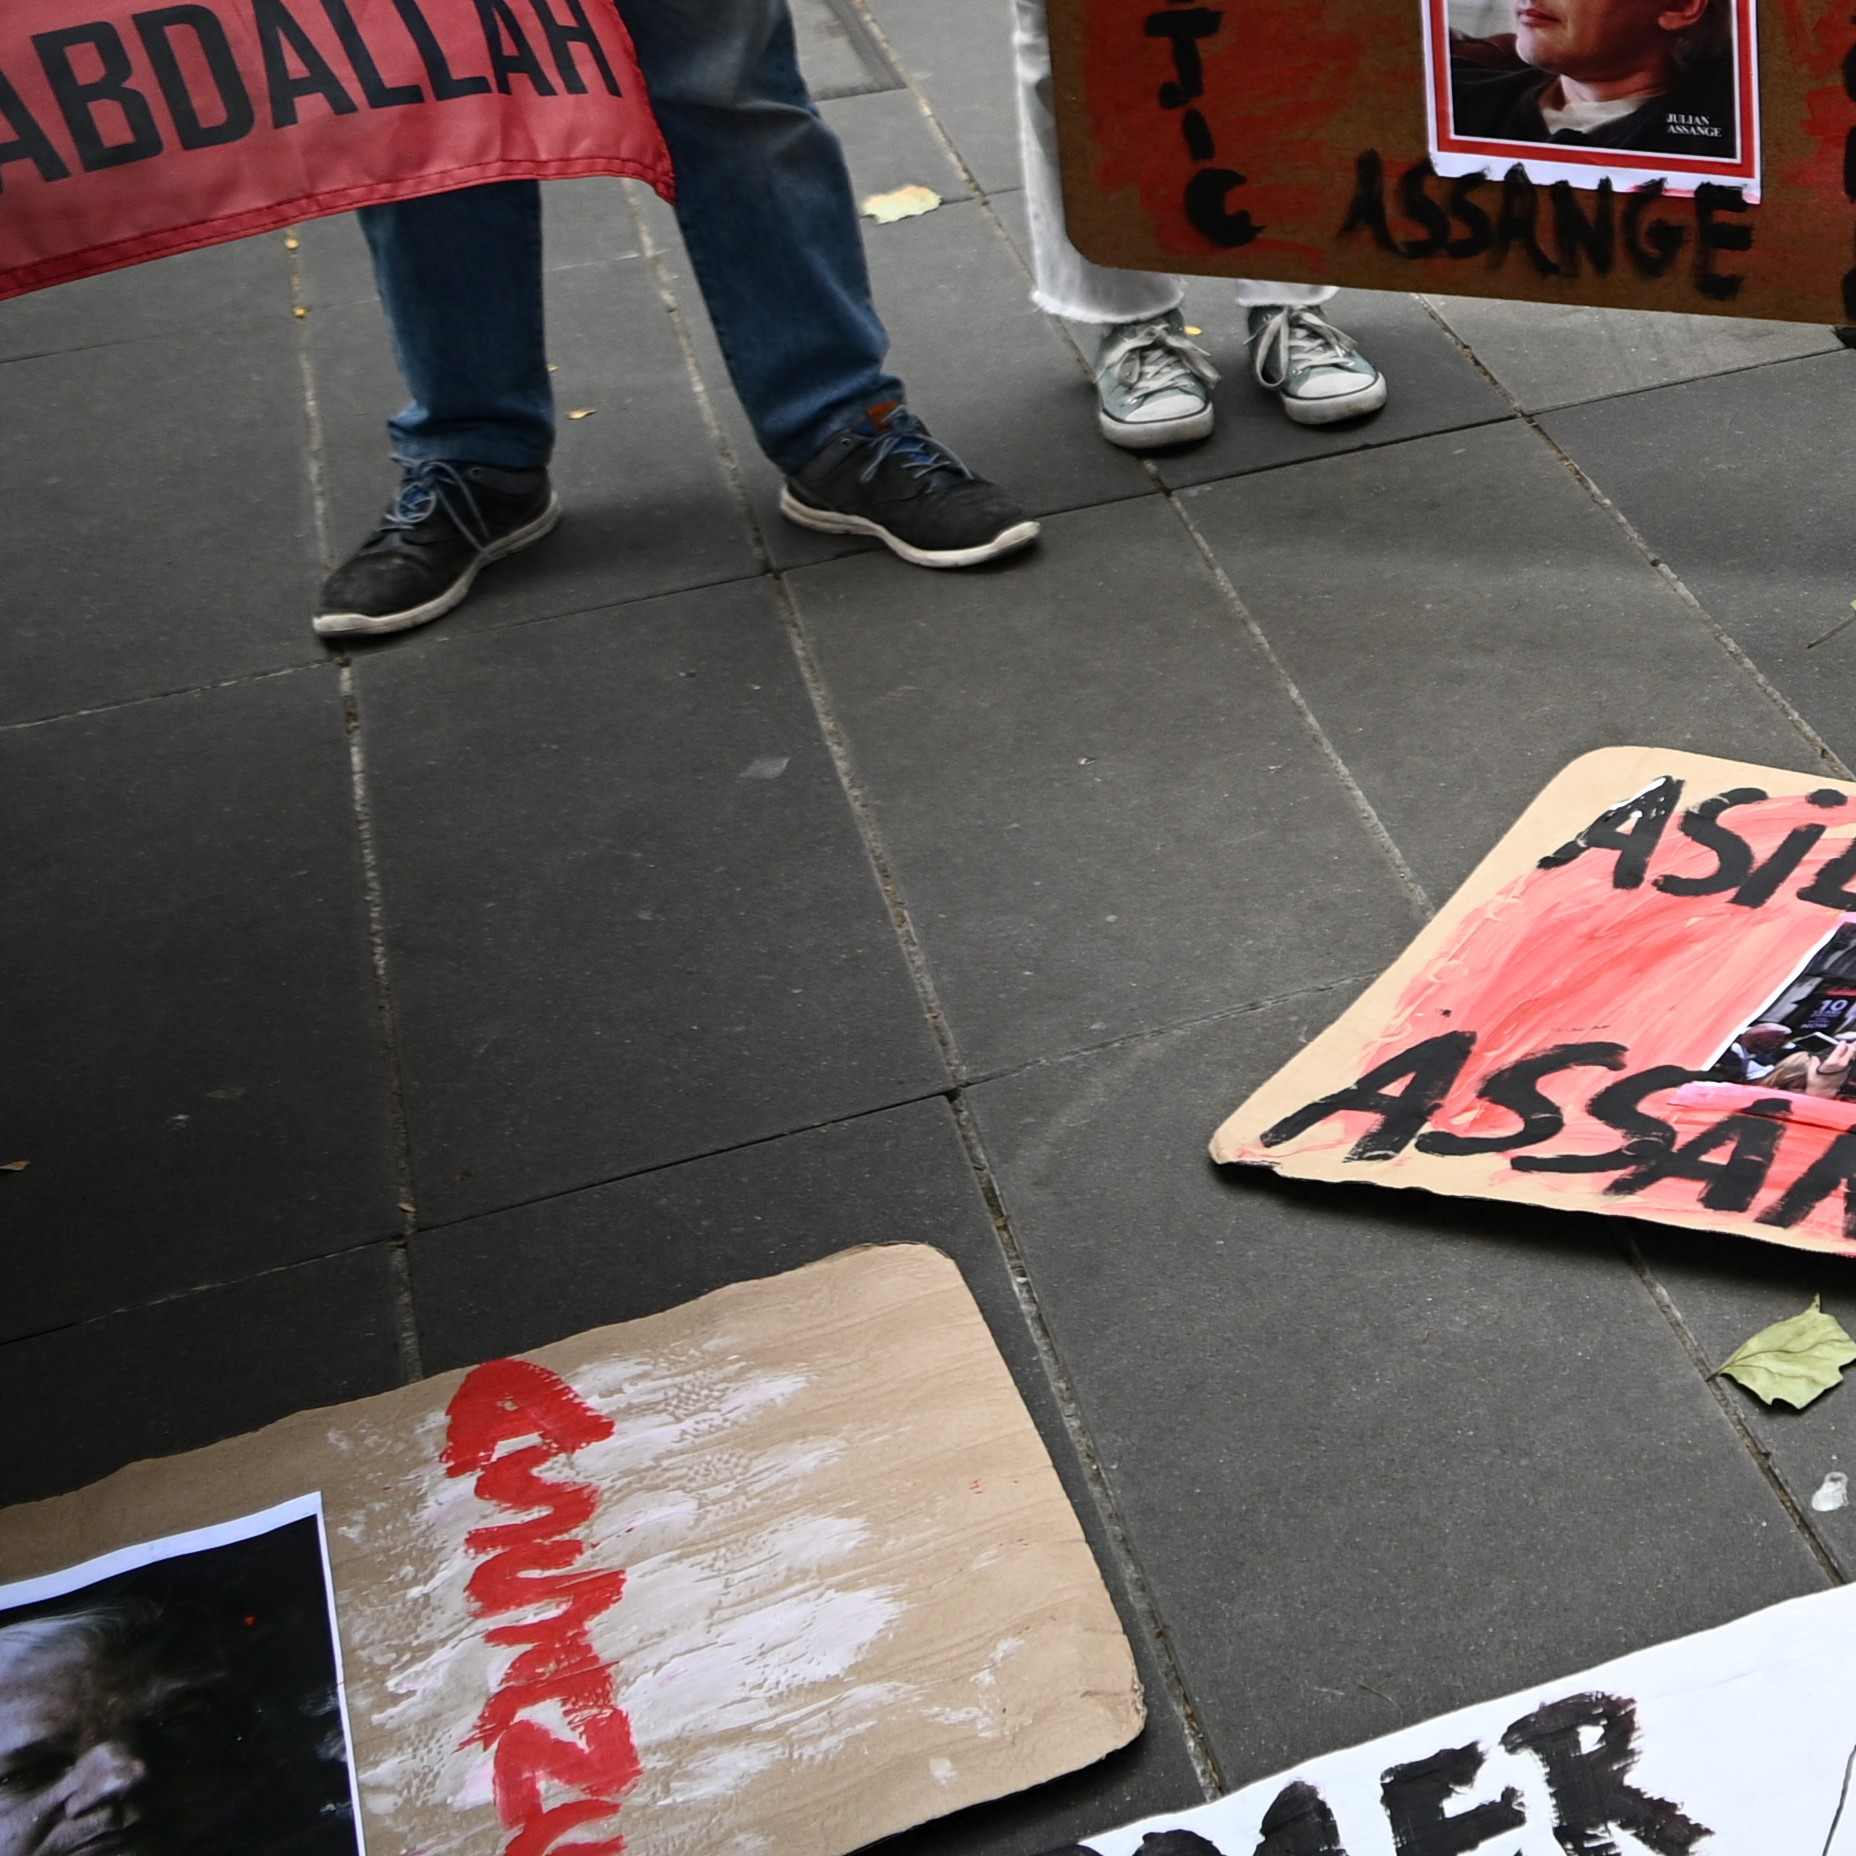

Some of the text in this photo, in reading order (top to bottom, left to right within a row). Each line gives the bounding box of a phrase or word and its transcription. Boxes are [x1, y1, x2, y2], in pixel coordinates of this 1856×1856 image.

[1666, 112, 1711, 126] JULIAN
[1666, 124, 1722, 138] ASSANGE
[1337, 148, 1756, 302] ASSANGE
